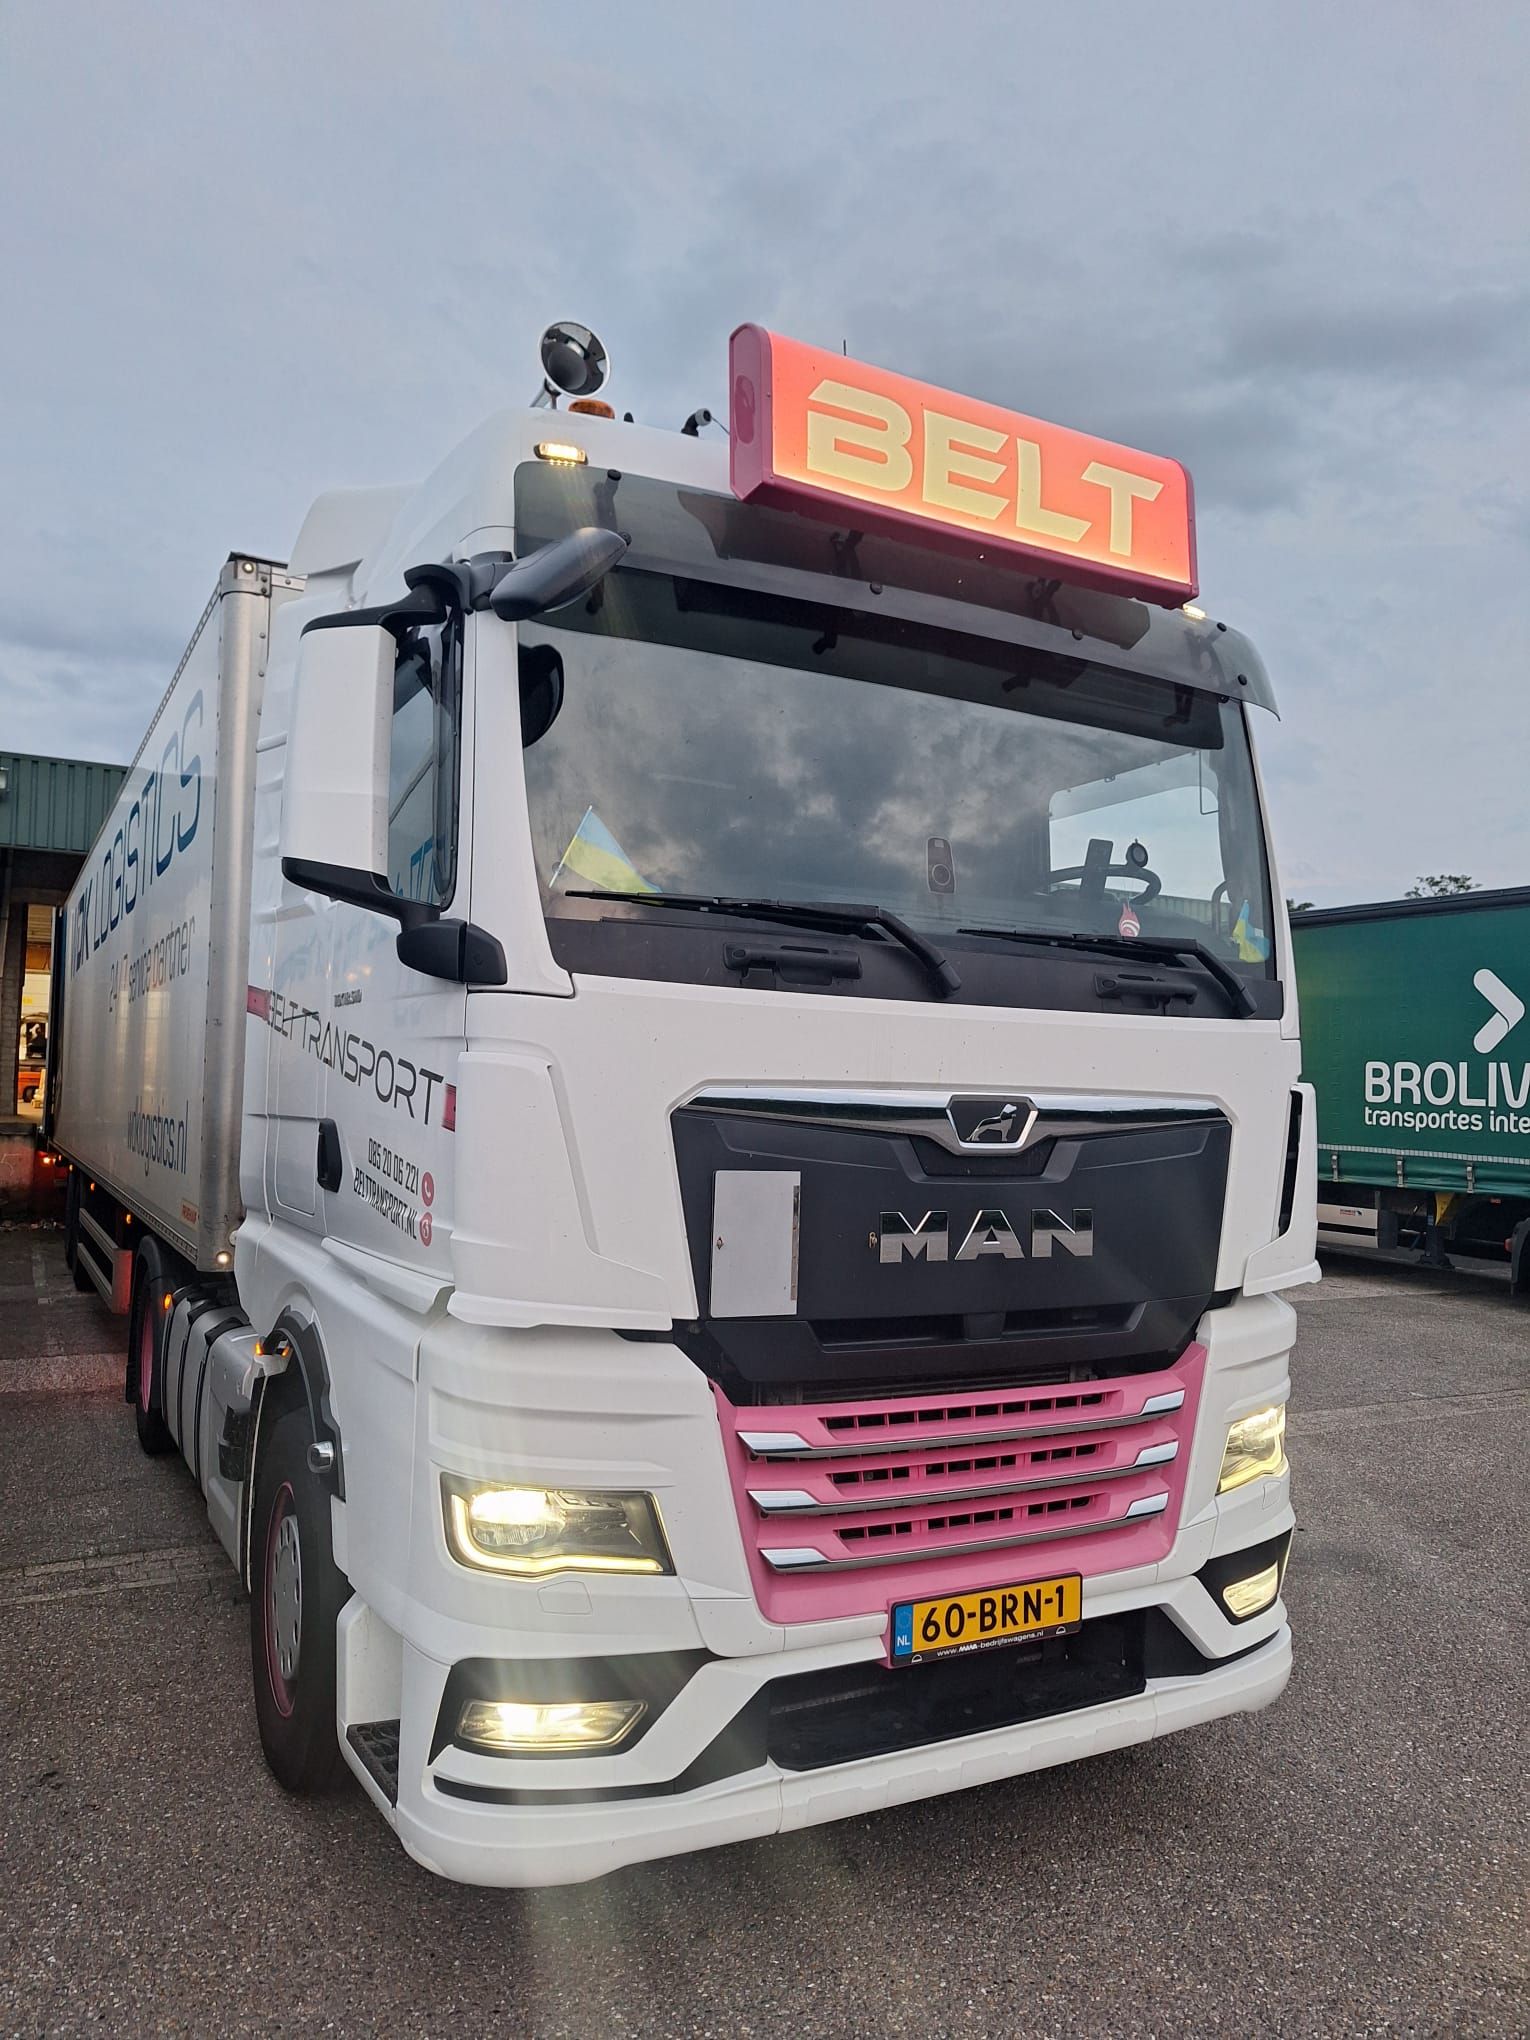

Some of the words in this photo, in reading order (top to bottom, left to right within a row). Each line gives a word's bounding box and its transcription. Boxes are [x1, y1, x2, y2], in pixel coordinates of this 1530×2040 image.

[806, 378, 1165, 557] BELT
[93, 688, 204, 952] LOGISTICS
[128, 938, 152, 1004] service
[151, 915, 195, 1000] partner
[1364, 1060, 1530, 1109] BROLIV
[1364, 1106, 1484, 1133] transportes
[1489, 1109, 1530, 1134] inte
[367, 1137, 382, 1171] 085
[382, 1146, 393, 1179] 20
[393, 1153, 405, 1186] 06
[405, 1161, 420, 1197] 221
[353, 1166, 419, 1241] BELTTRANSPORT.NL
[879, 1208, 1095, 1264] MAN
[897, 1635, 911, 1648] NL
[921, 1584, 1066, 1643] 60-BRN-1
